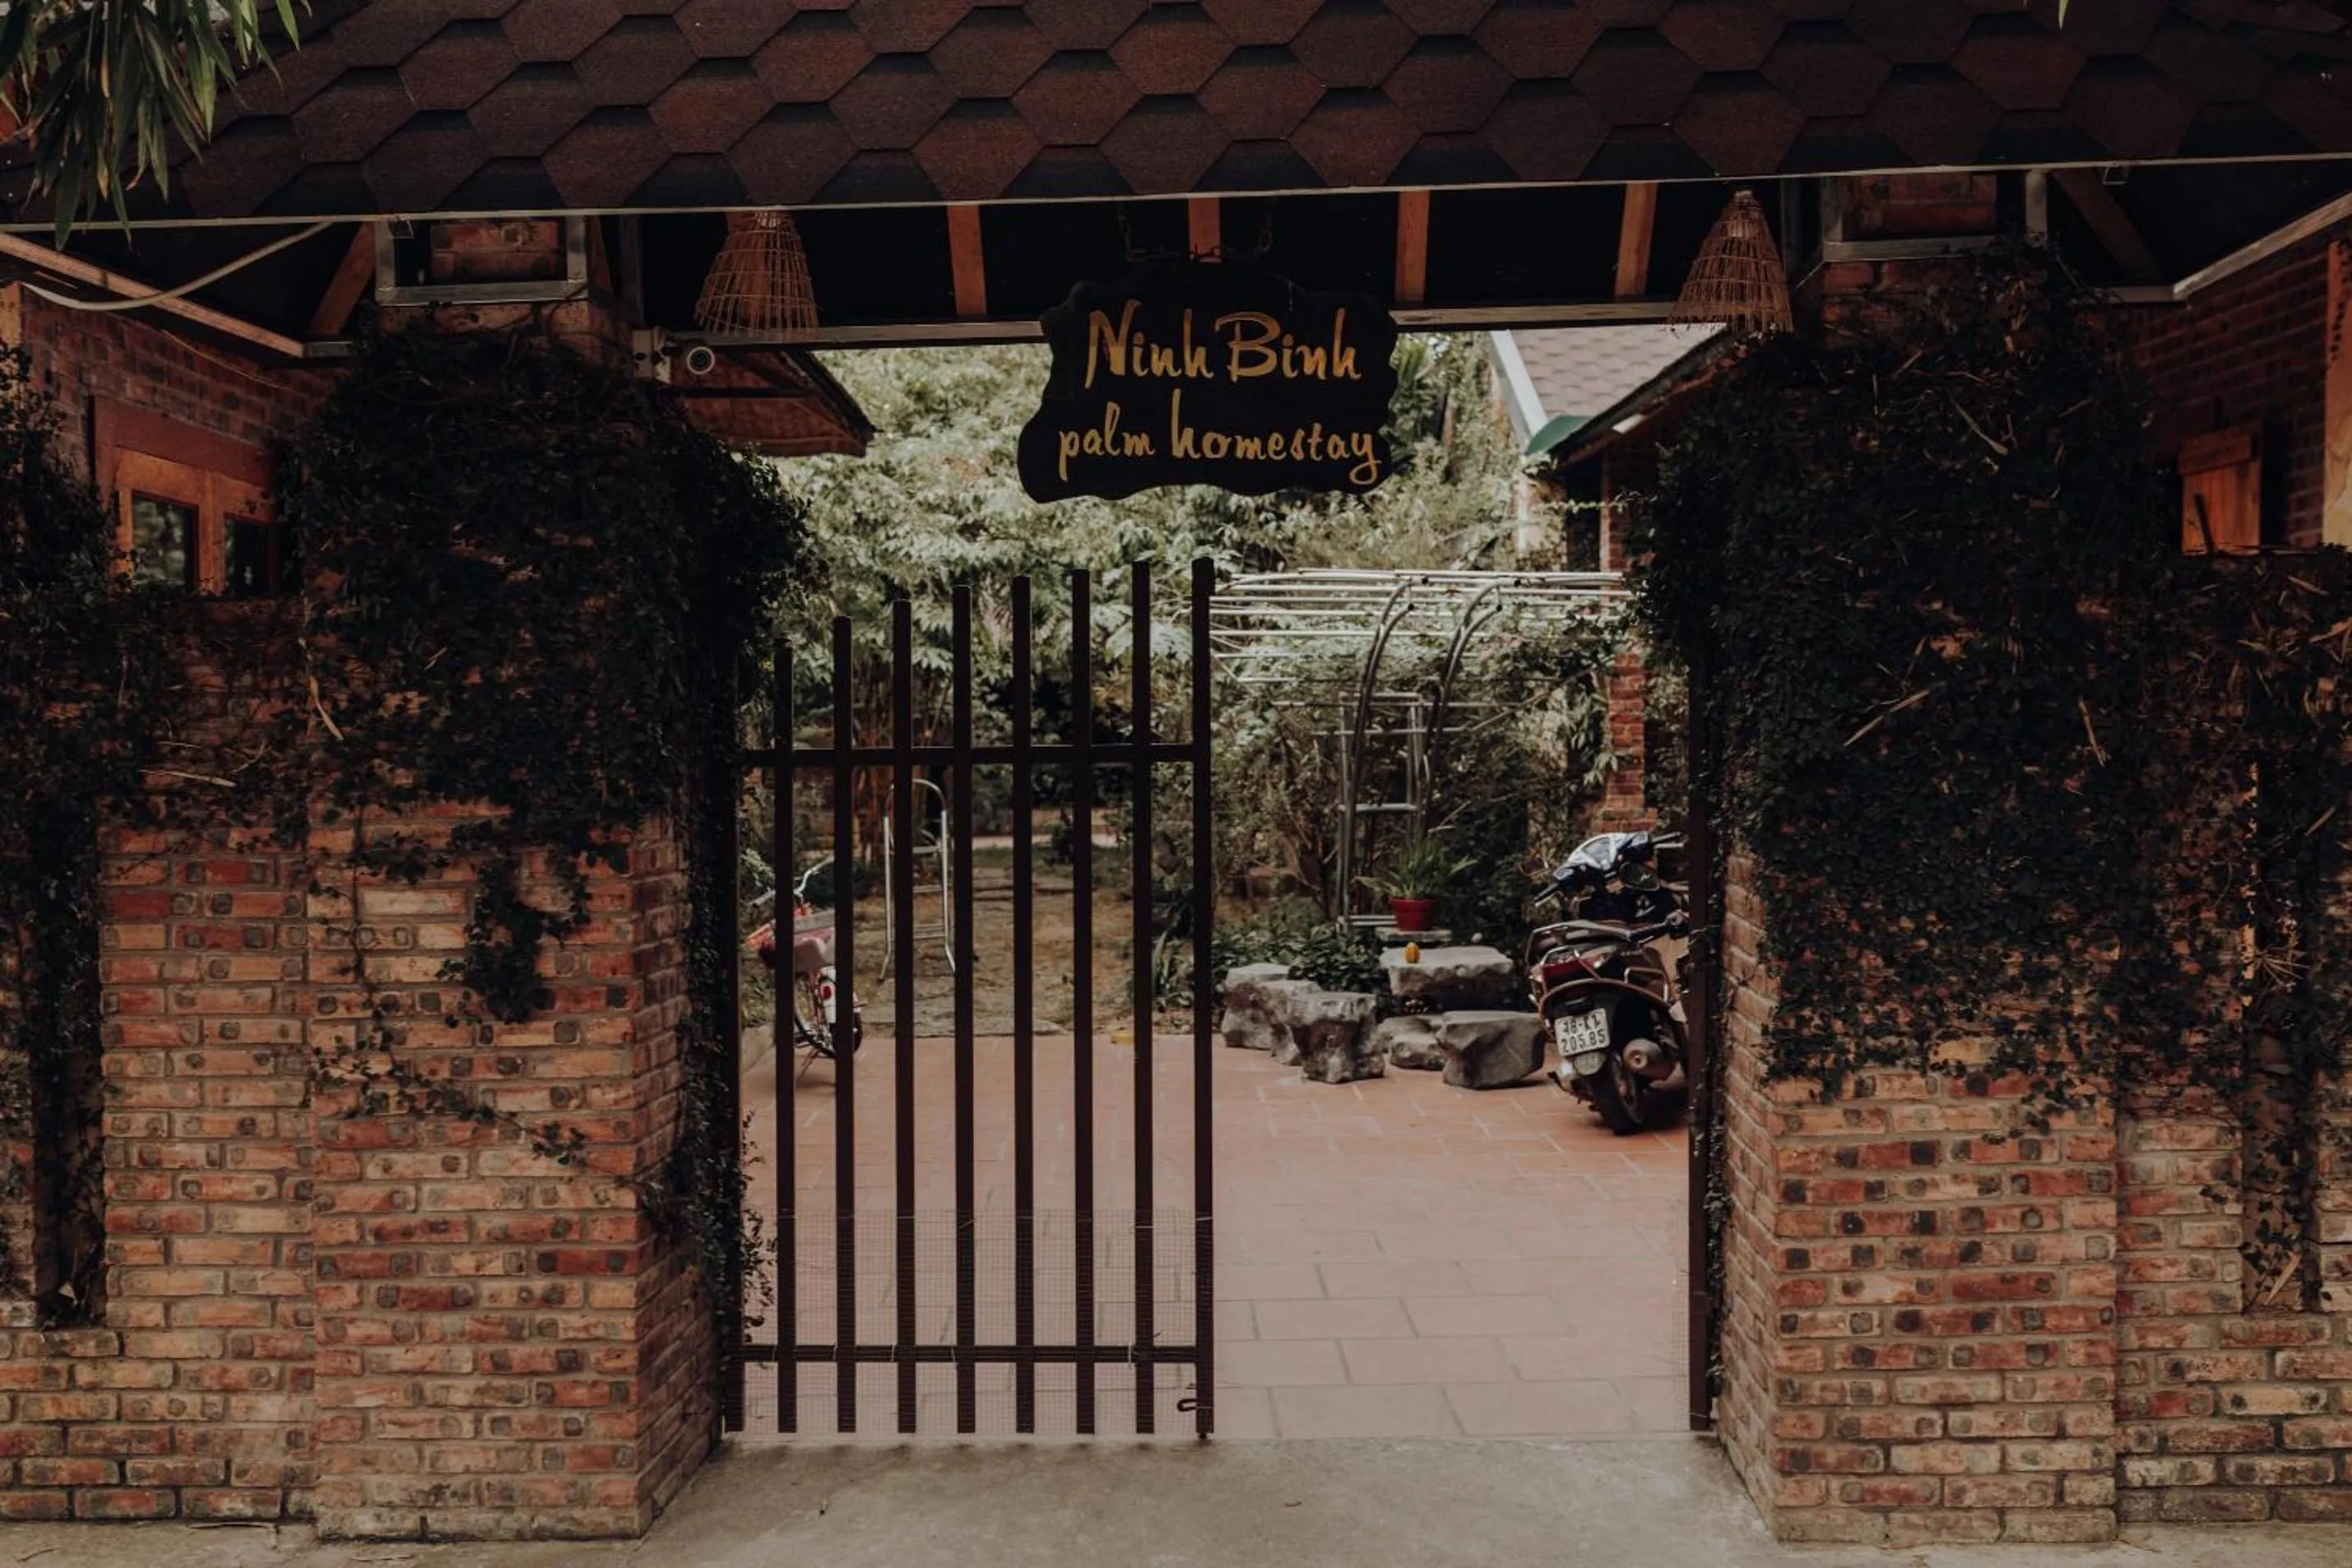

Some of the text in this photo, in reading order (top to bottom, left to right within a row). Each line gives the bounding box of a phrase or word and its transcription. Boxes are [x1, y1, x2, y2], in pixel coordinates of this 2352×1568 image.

[1084, 299, 1362, 390] Ninh Binh
[1057, 387, 1382, 485] palm homestay
